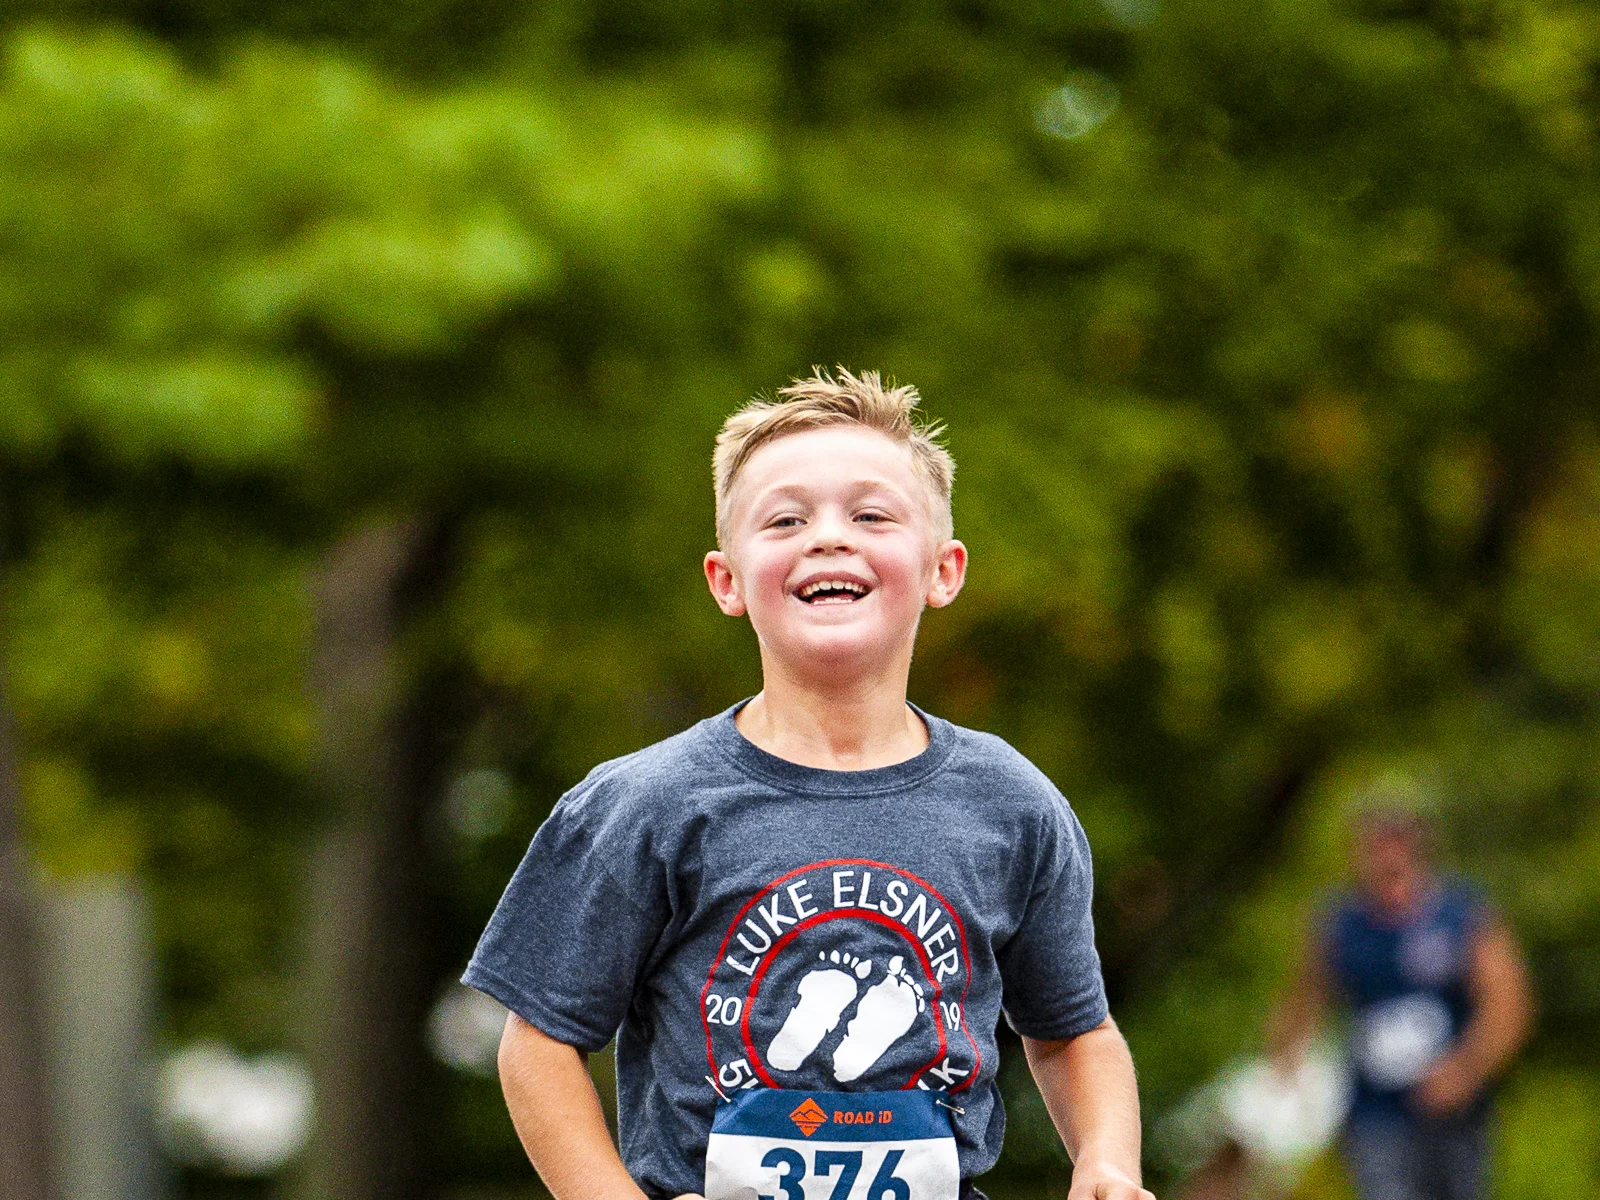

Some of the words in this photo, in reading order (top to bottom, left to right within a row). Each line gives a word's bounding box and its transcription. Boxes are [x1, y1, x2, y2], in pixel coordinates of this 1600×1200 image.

[726, 878, 818, 976] LUKE
[832, 870, 959, 982] ELSNER
[705, 994, 742, 1026] 20
[940, 1001, 960, 1031] 19
[917, 1057, 970, 1090] K
[833, 1110, 875, 1124] ROAD
[878, 1110, 893, 1124] iD
